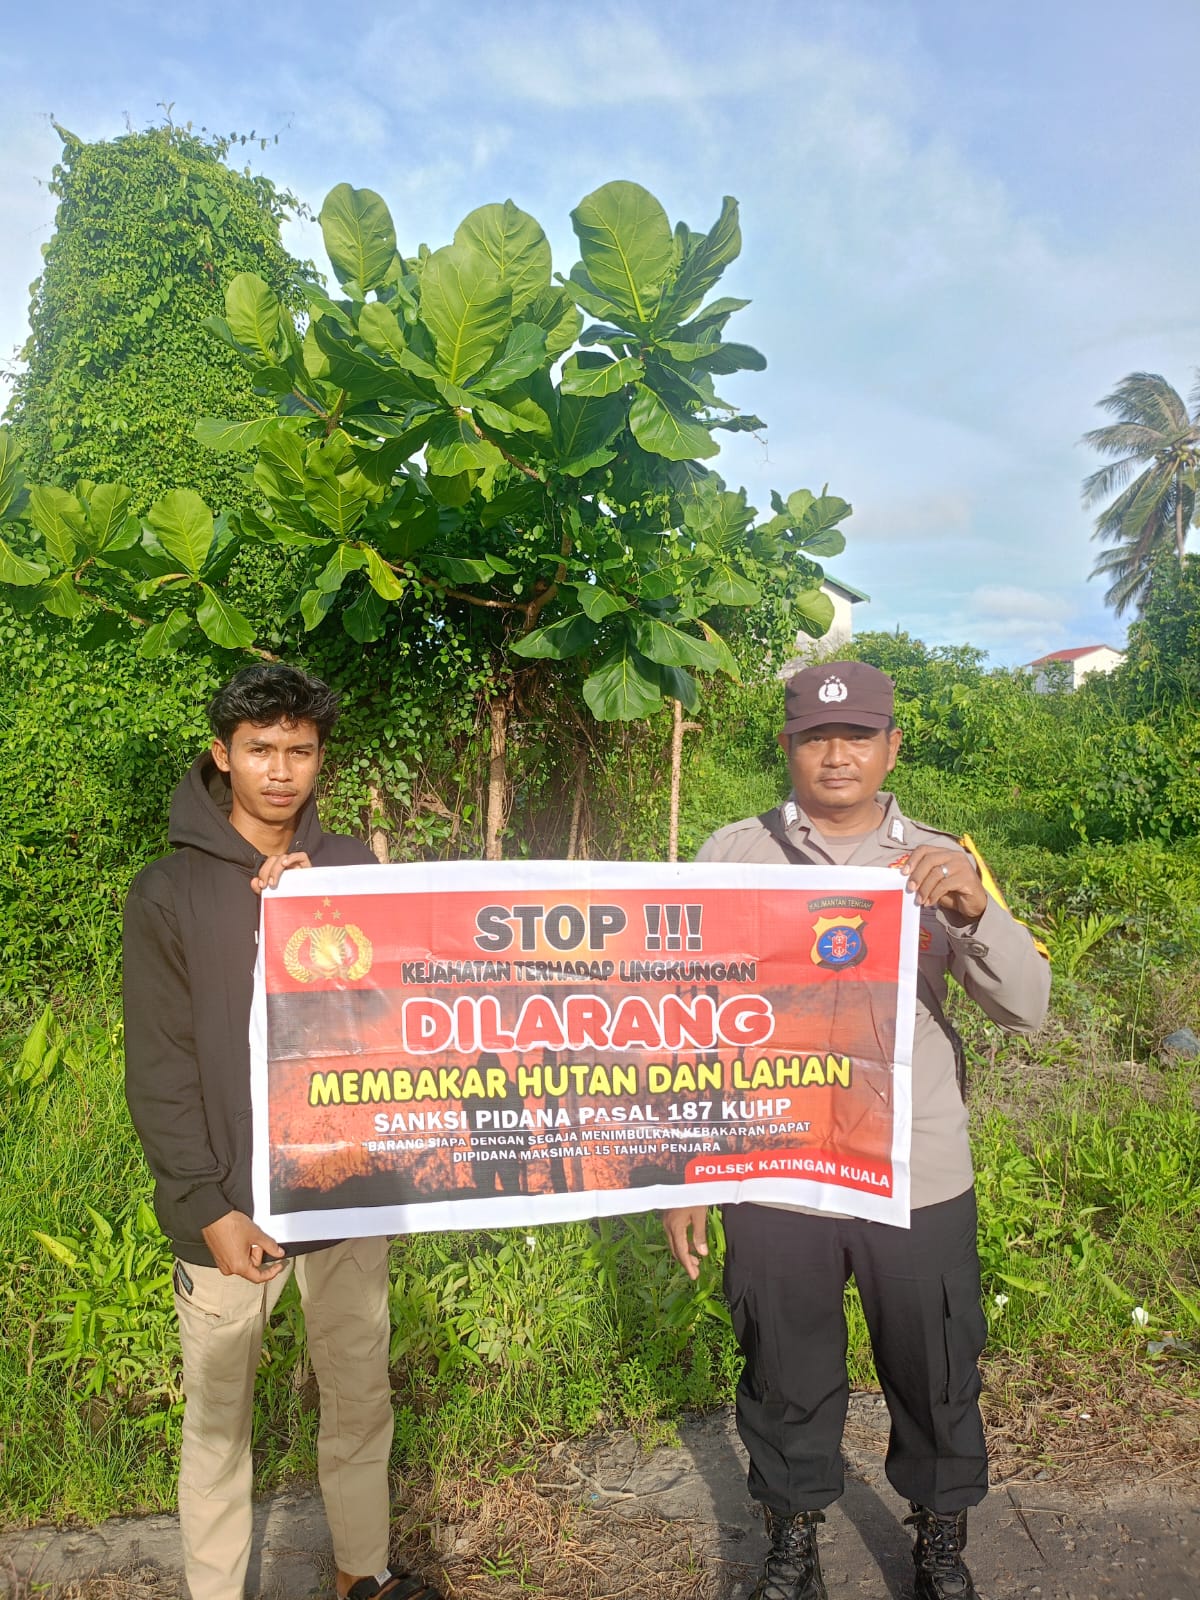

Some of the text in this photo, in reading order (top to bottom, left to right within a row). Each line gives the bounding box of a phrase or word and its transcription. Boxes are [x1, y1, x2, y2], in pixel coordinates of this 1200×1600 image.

[808, 899, 872, 909] KALIMANTAN TENGAH
[474, 904, 703, 951] STOP !!!
[402, 960, 756, 984] KEJAHATAN TERHADAP LINGKUNGAN
[401, 994, 775, 1055] DILARANG
[309, 1054, 850, 1106] MEMBAKAR HUTAN DAN LAHAN
[374, 1098, 792, 1132] SANKSI PIDANA PASAL 187 KUHP
[427, 1136, 466, 1149] SIAPA
[470, 1135, 524, 1146] DENGAN
[528, 1131, 577, 1144] SEGAJA
[581, 1126, 680, 1141] MENIMBULKAN
[683, 1125, 765, 1137] KEBAKARAN
[769, 1122, 810, 1133] DAPAT
[453, 1141, 721, 1163] DIPIDANA MAKSIMAL 15 TAHUN PENJARA
[694, 1158, 890, 1188] POLSEK KATINGAN KUALA
